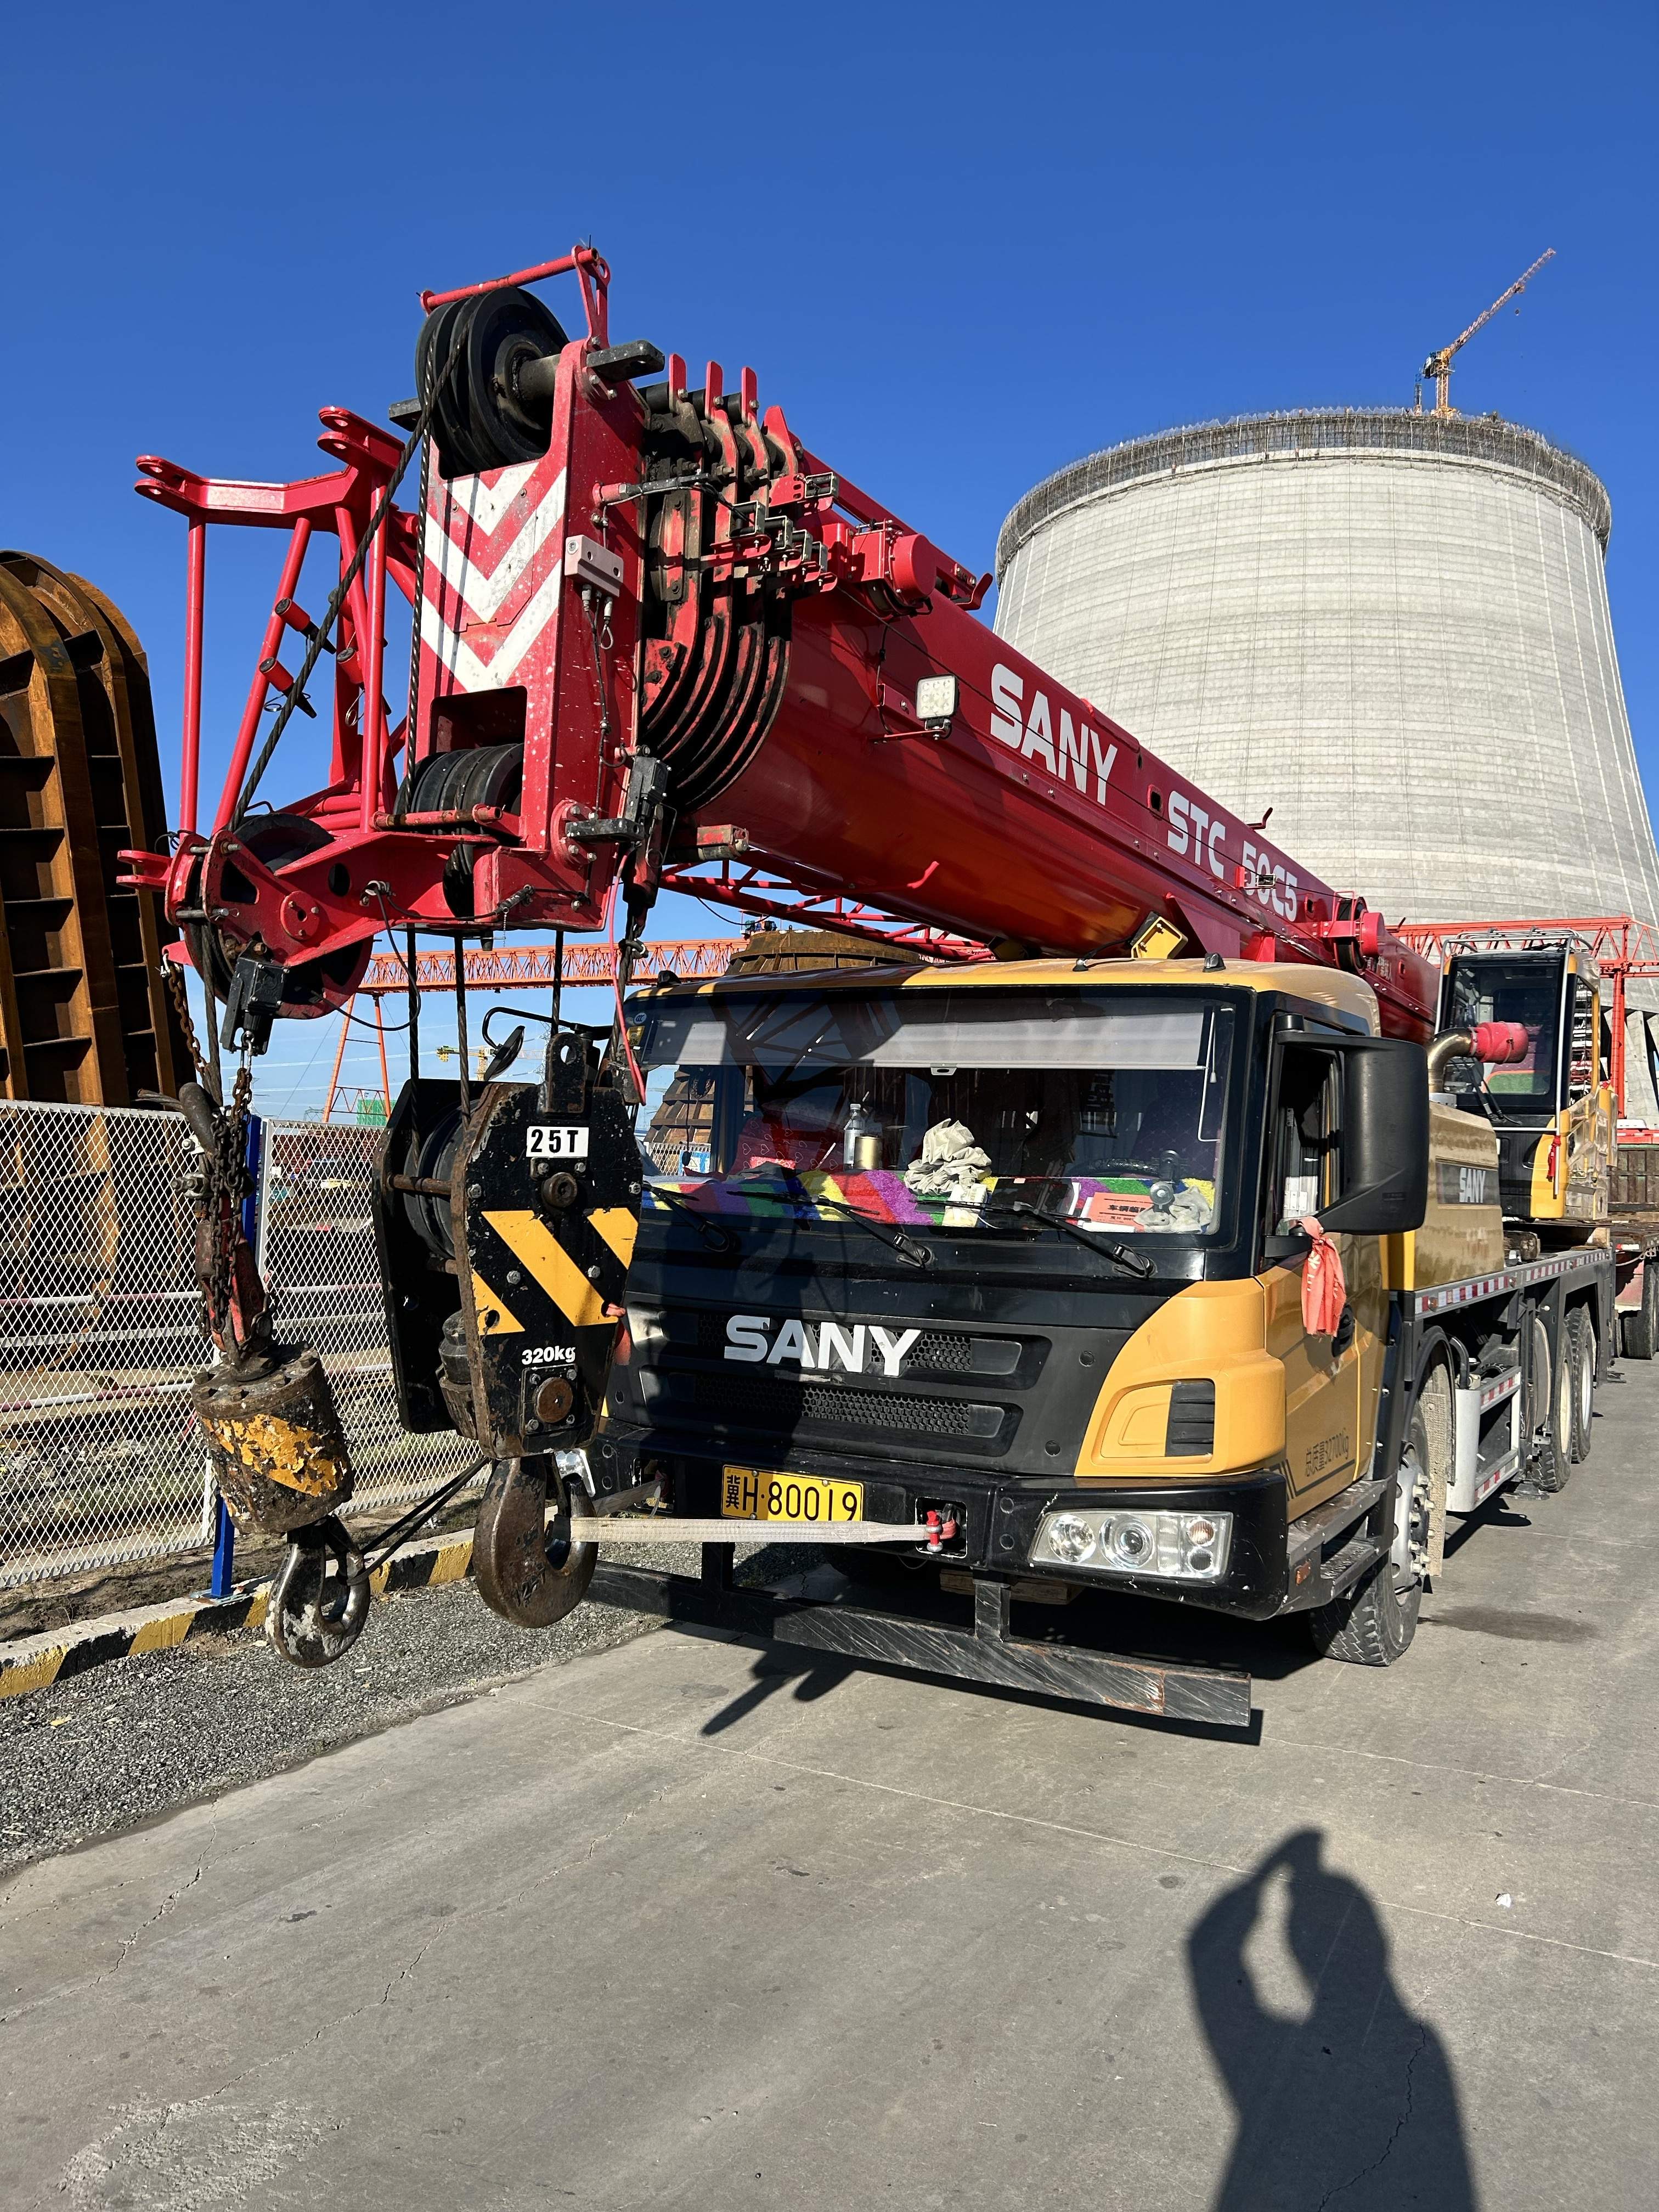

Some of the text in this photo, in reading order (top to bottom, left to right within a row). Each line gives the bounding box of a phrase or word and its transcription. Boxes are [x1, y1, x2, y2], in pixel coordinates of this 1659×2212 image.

[990, 663, 1118, 806] SANY
[1167, 790, 1297, 922] STC 50C5
[531, 1128, 579, 1153] 25T
[1459, 1167, 1486, 1204] SANY
[521, 1345, 575, 1365] 320kg
[724, 1314, 921, 1376] SANY
